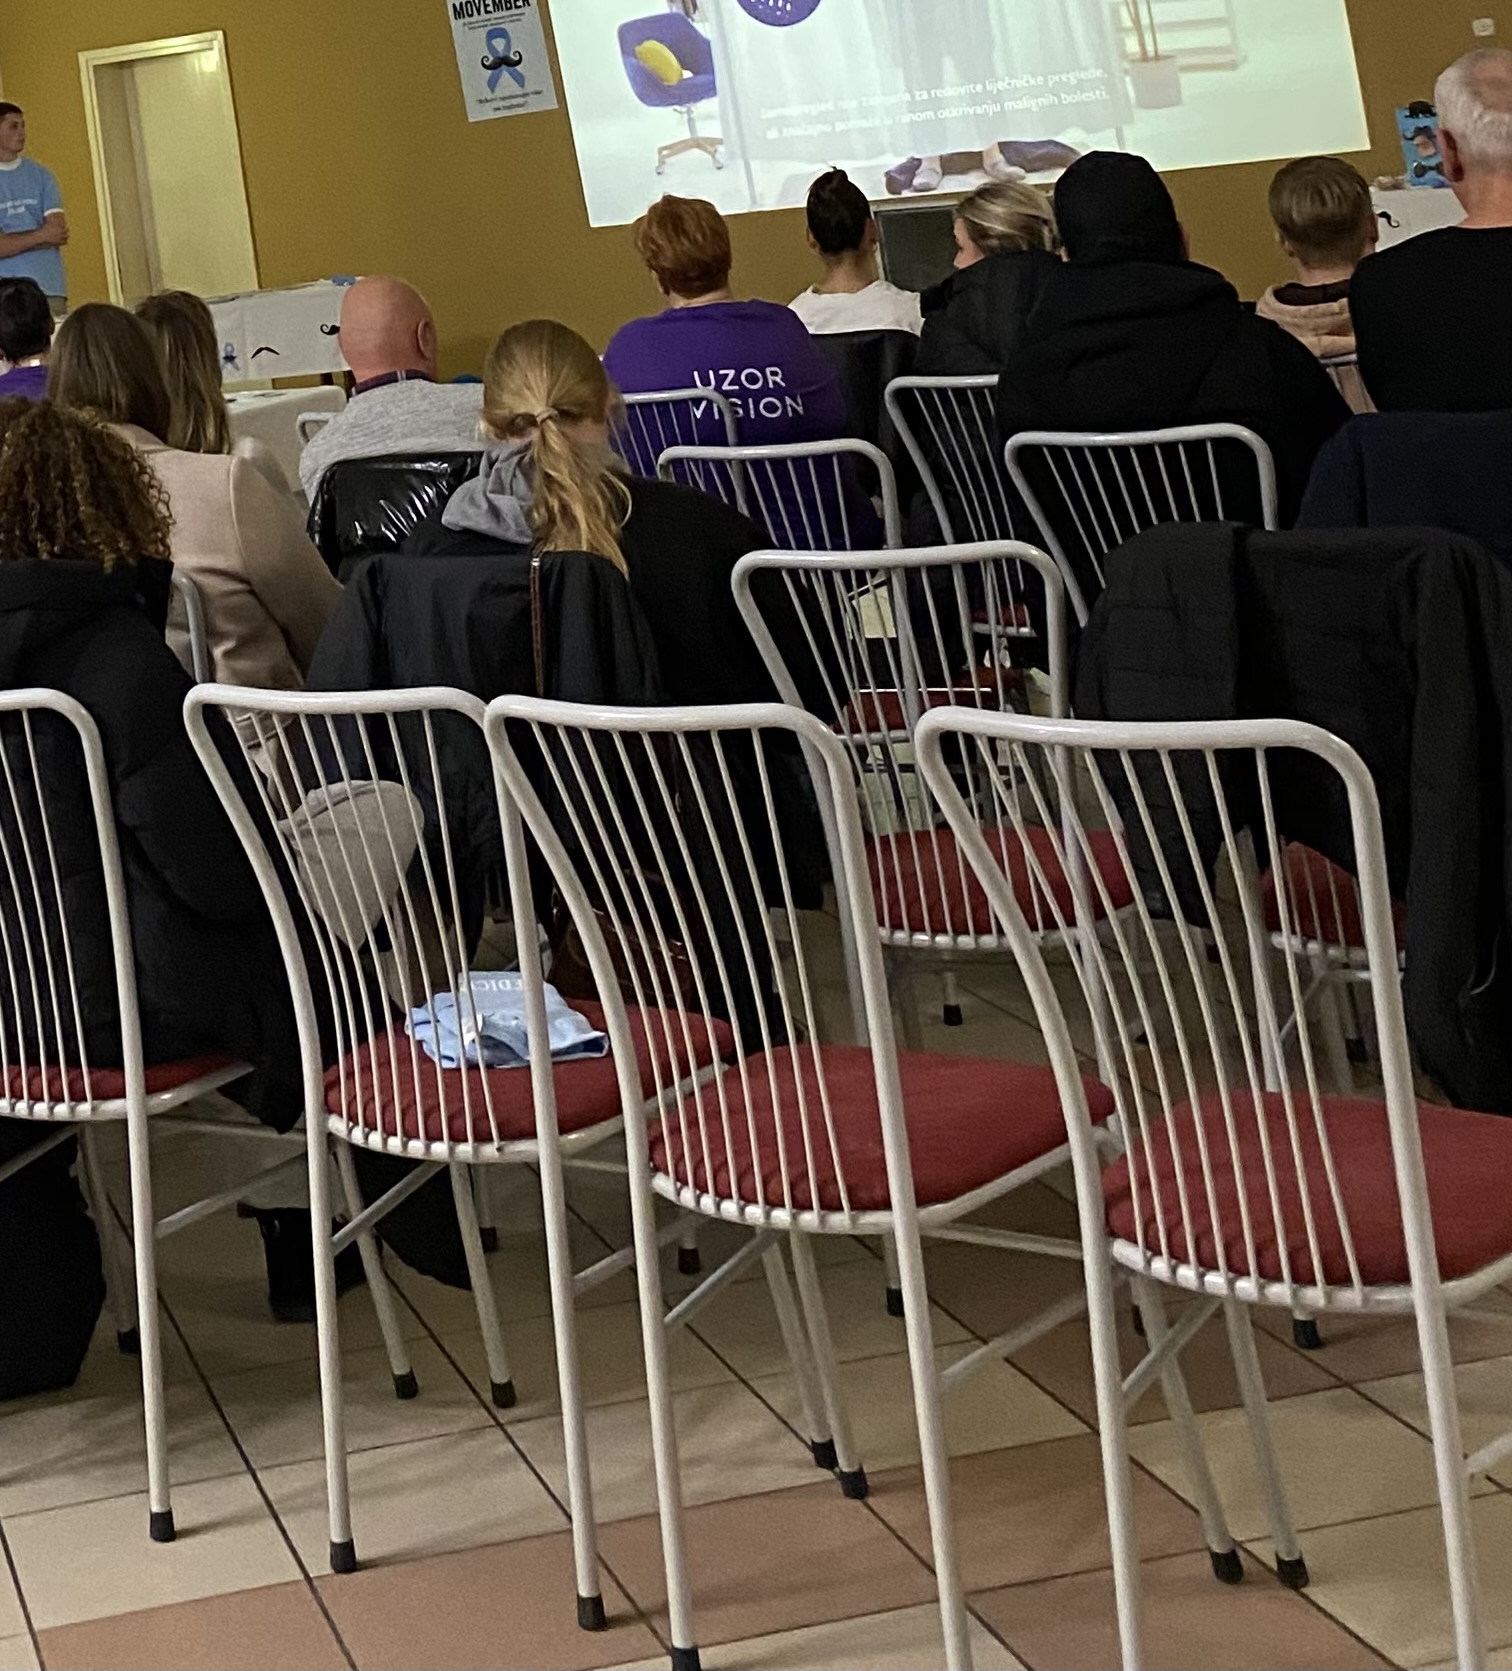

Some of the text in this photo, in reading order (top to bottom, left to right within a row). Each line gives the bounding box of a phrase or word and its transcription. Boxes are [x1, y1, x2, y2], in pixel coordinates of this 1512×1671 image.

[914, 89, 929, 101] za
[895, 109, 935, 124] ranom
[1004, 92, 1058, 112] malignih
[693, 366, 786, 391] UZOR
